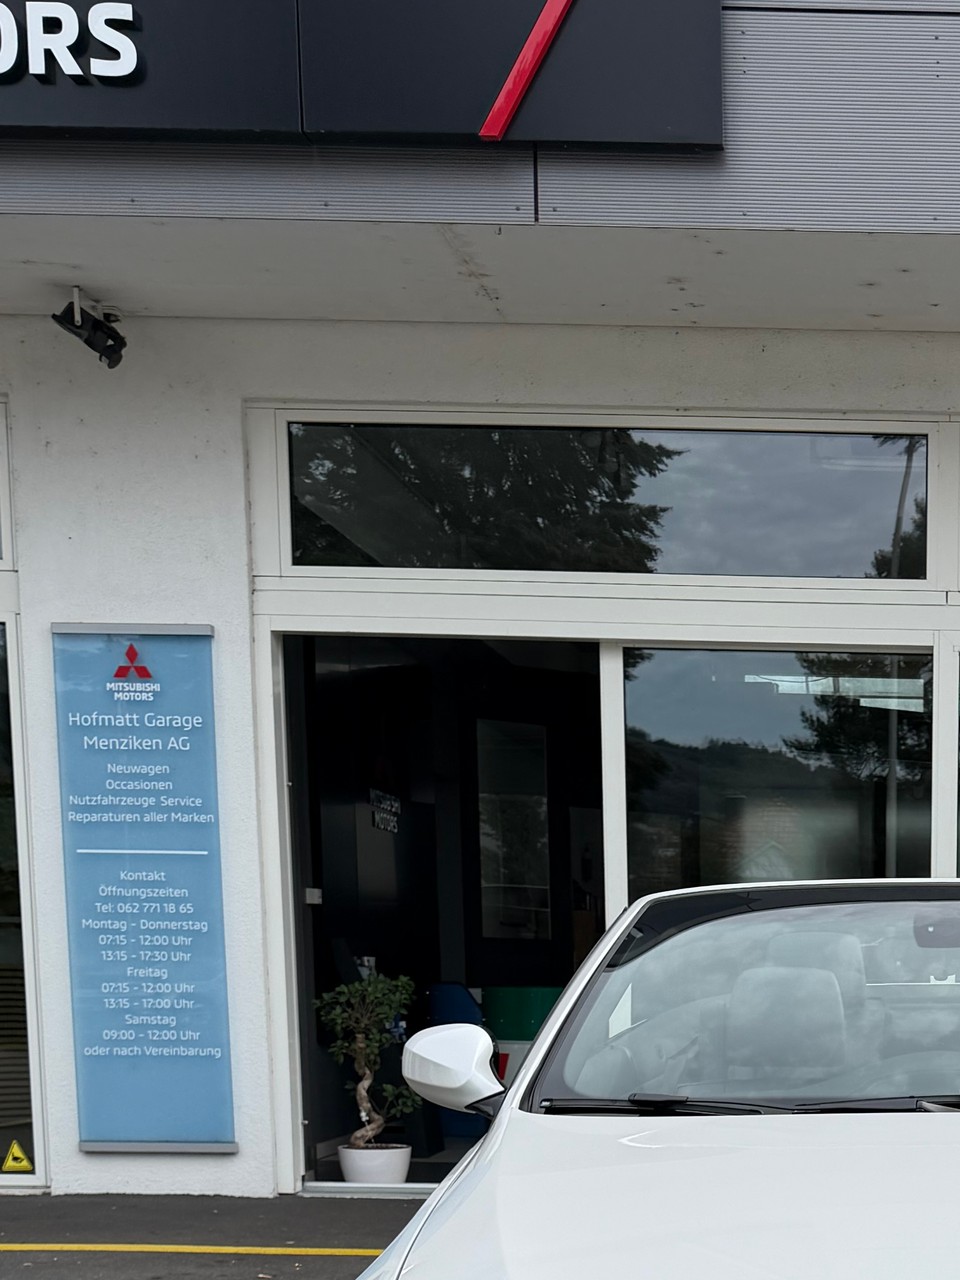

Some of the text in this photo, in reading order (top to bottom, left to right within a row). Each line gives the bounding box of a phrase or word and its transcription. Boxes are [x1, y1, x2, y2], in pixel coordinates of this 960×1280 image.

[106, 682, 161, 692] MITSUBISHI
[114, 692, 154, 701] MOTORS
[68, 711, 203, 731] Hofmatt Garage
[83, 736, 191, 751] Menziken AG
[107, 763, 170, 776] Neuwagen
[105, 779, 173, 790] Occasionen
[69, 795, 203, 808] Nutzfahrzeuge Service
[68, 811, 214, 824] Reparaturen aller Marken
[120, 871, 166, 881] Kontakt
[98, 884, 188, 899] Öffnungszeiten
[95, 903, 194, 914] Tel: 062 771 18 65
[81, 918, 127, 931] Montag
[140, 919, 208, 932] Donnerstag
[98, 935, 127, 945] 07:15
[139, 935, 169, 945] 12:00
[172, 935, 193, 946] Uhr
[101, 951, 128, 961] 13:15
[139, 951, 168, 961] 17:30
[171, 951, 192, 961] Uhr
[126, 966, 168, 979] Freitag
[101, 983, 130, 993] 07:15
[141, 983, 171, 993] 12:00
[174, 983, 195, 993] Uhr
[104, 999, 130, 1009] 13:15
[142, 999, 171, 1009] 17:00
[174, 999, 195, 1009] Uhr
[125, 1014, 177, 1027] Samstag
[102, 1030, 135, 1040] 09:00
[147, 1030, 177, 1040] 12:00
[180, 1030, 201, 1041] Uhr
[84, 1045, 222, 1058] oder nach Vereinbarung
